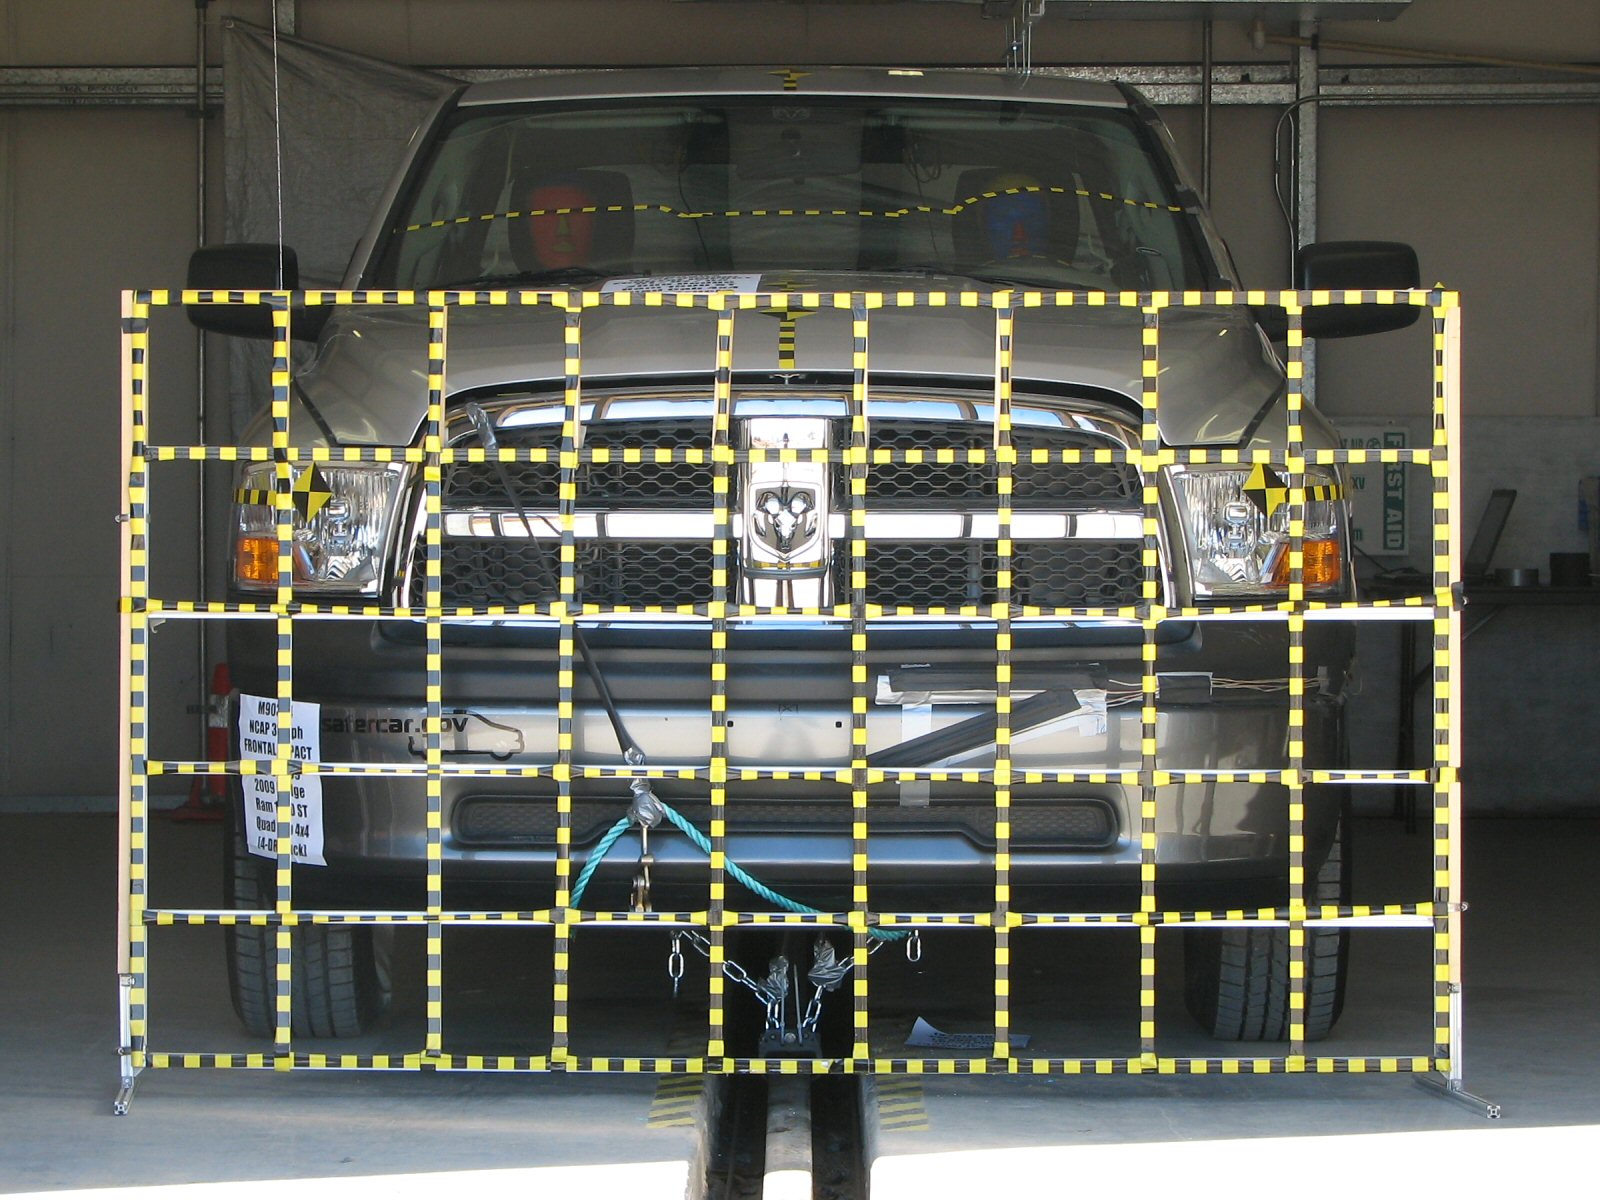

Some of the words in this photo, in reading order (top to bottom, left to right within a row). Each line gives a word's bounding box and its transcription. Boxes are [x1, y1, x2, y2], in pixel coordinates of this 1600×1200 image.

[1386, 507, 1404, 549] AID
[249, 720, 270, 735] NCAP
[244, 738, 277, 756] FRONTAL
[254, 778, 276, 794] 2009
[255, 797, 273, 813] Ram
[296, 803, 307, 818] ST
[256, 816, 276, 832] Quad
[295, 823, 309, 838] 4x4
